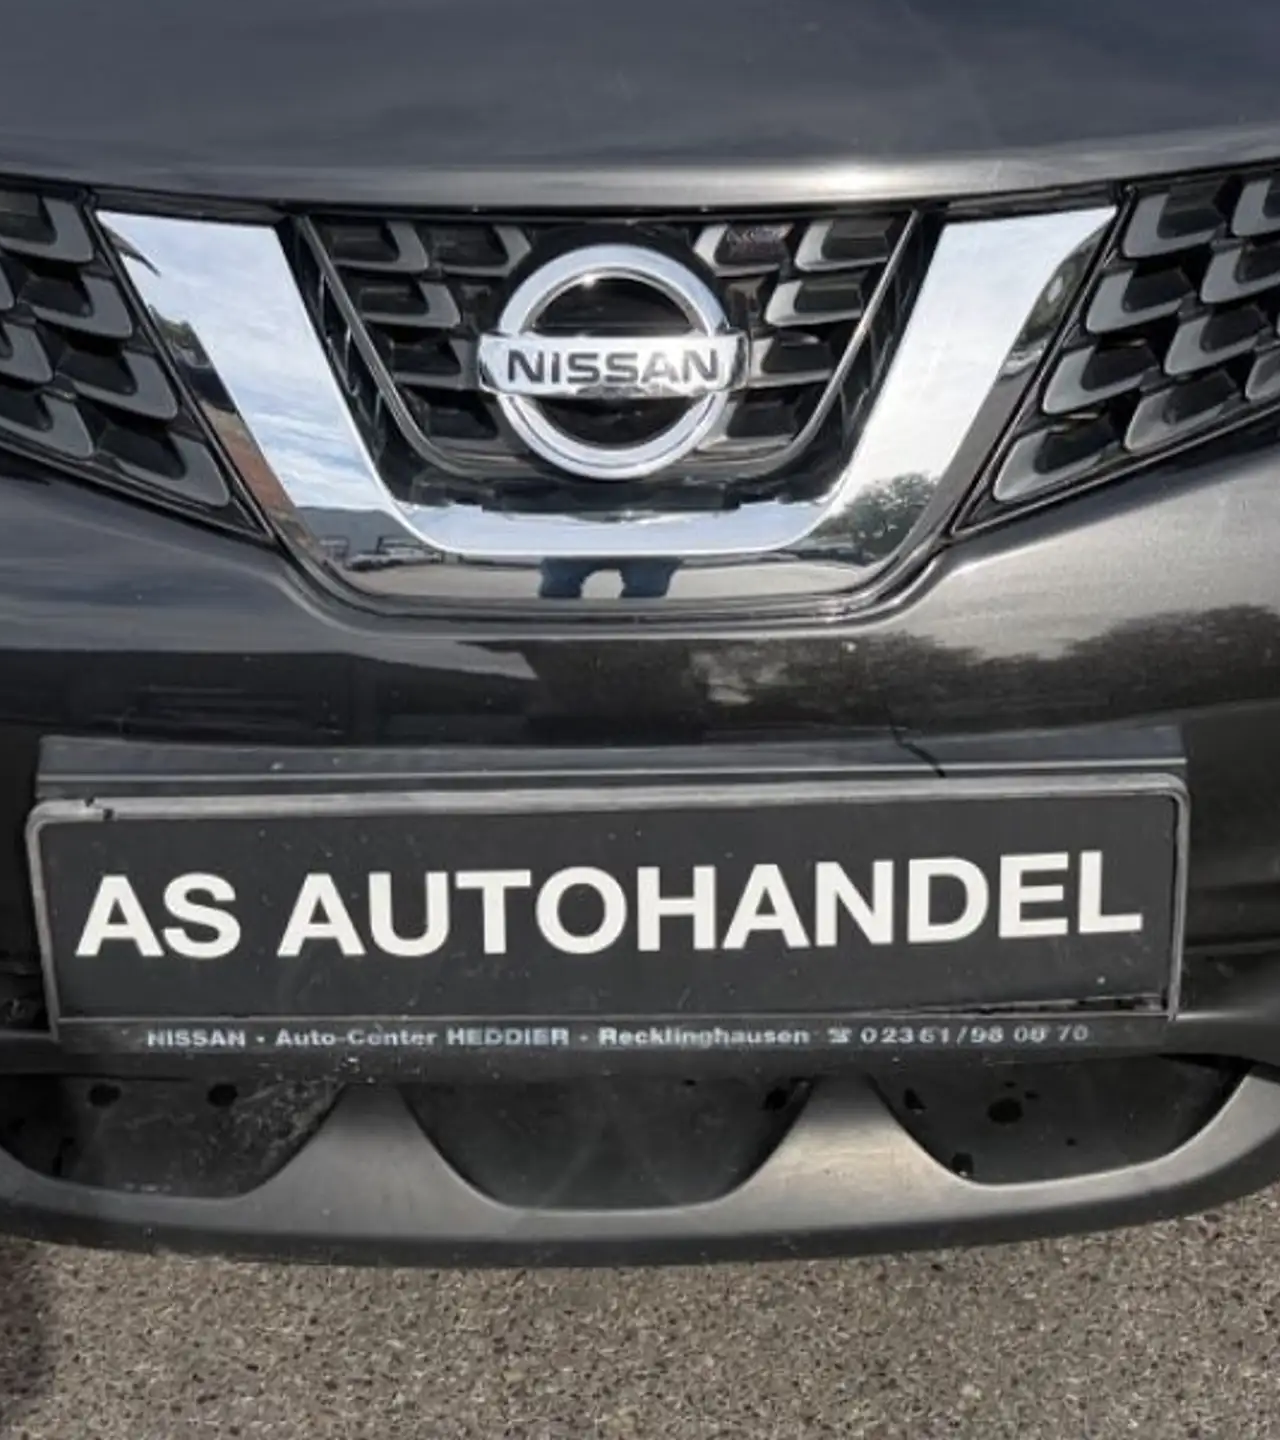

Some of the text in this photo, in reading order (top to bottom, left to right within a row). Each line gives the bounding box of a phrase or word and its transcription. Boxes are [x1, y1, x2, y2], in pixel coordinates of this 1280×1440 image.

[507, 348, 719, 385] NISSAN
[75, 849, 1144, 959] AS AUTOHANDEL
[147, 1028, 246, 1048] NISSAN
[598, 1025, 811, 1049] Recklinghausen
